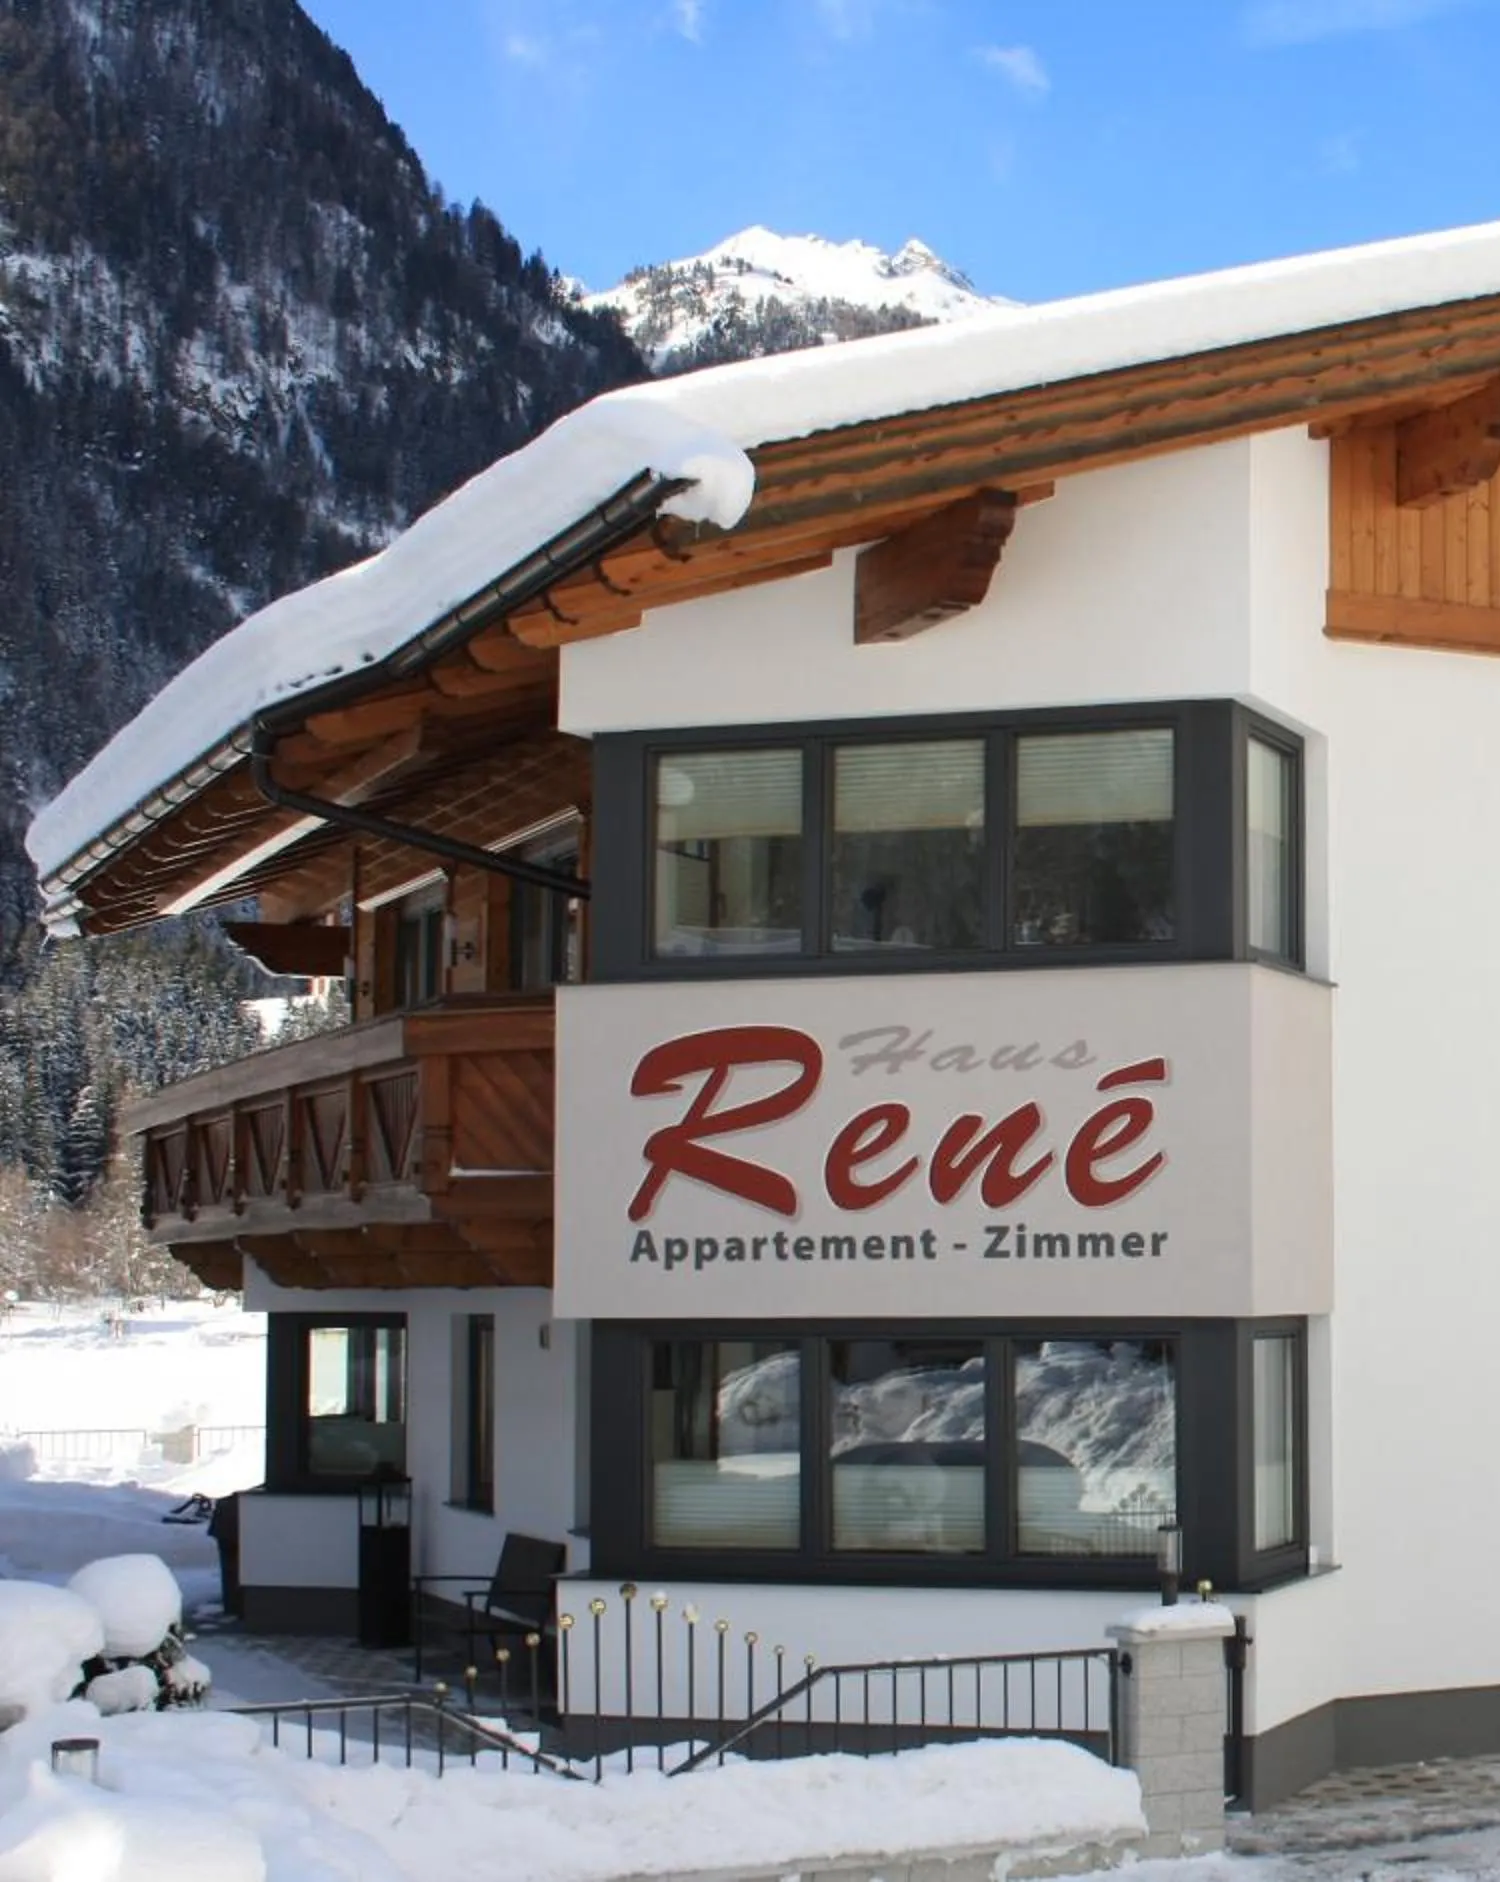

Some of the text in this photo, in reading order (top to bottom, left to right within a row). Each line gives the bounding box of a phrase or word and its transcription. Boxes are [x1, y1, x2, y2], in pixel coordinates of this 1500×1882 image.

[838, 1025, 1097, 1076] Haus
[629, 1025, 1166, 1221] René
[630, 1229, 937, 1271] Appartement
[983, 1224, 1168, 1259] Zimmer
